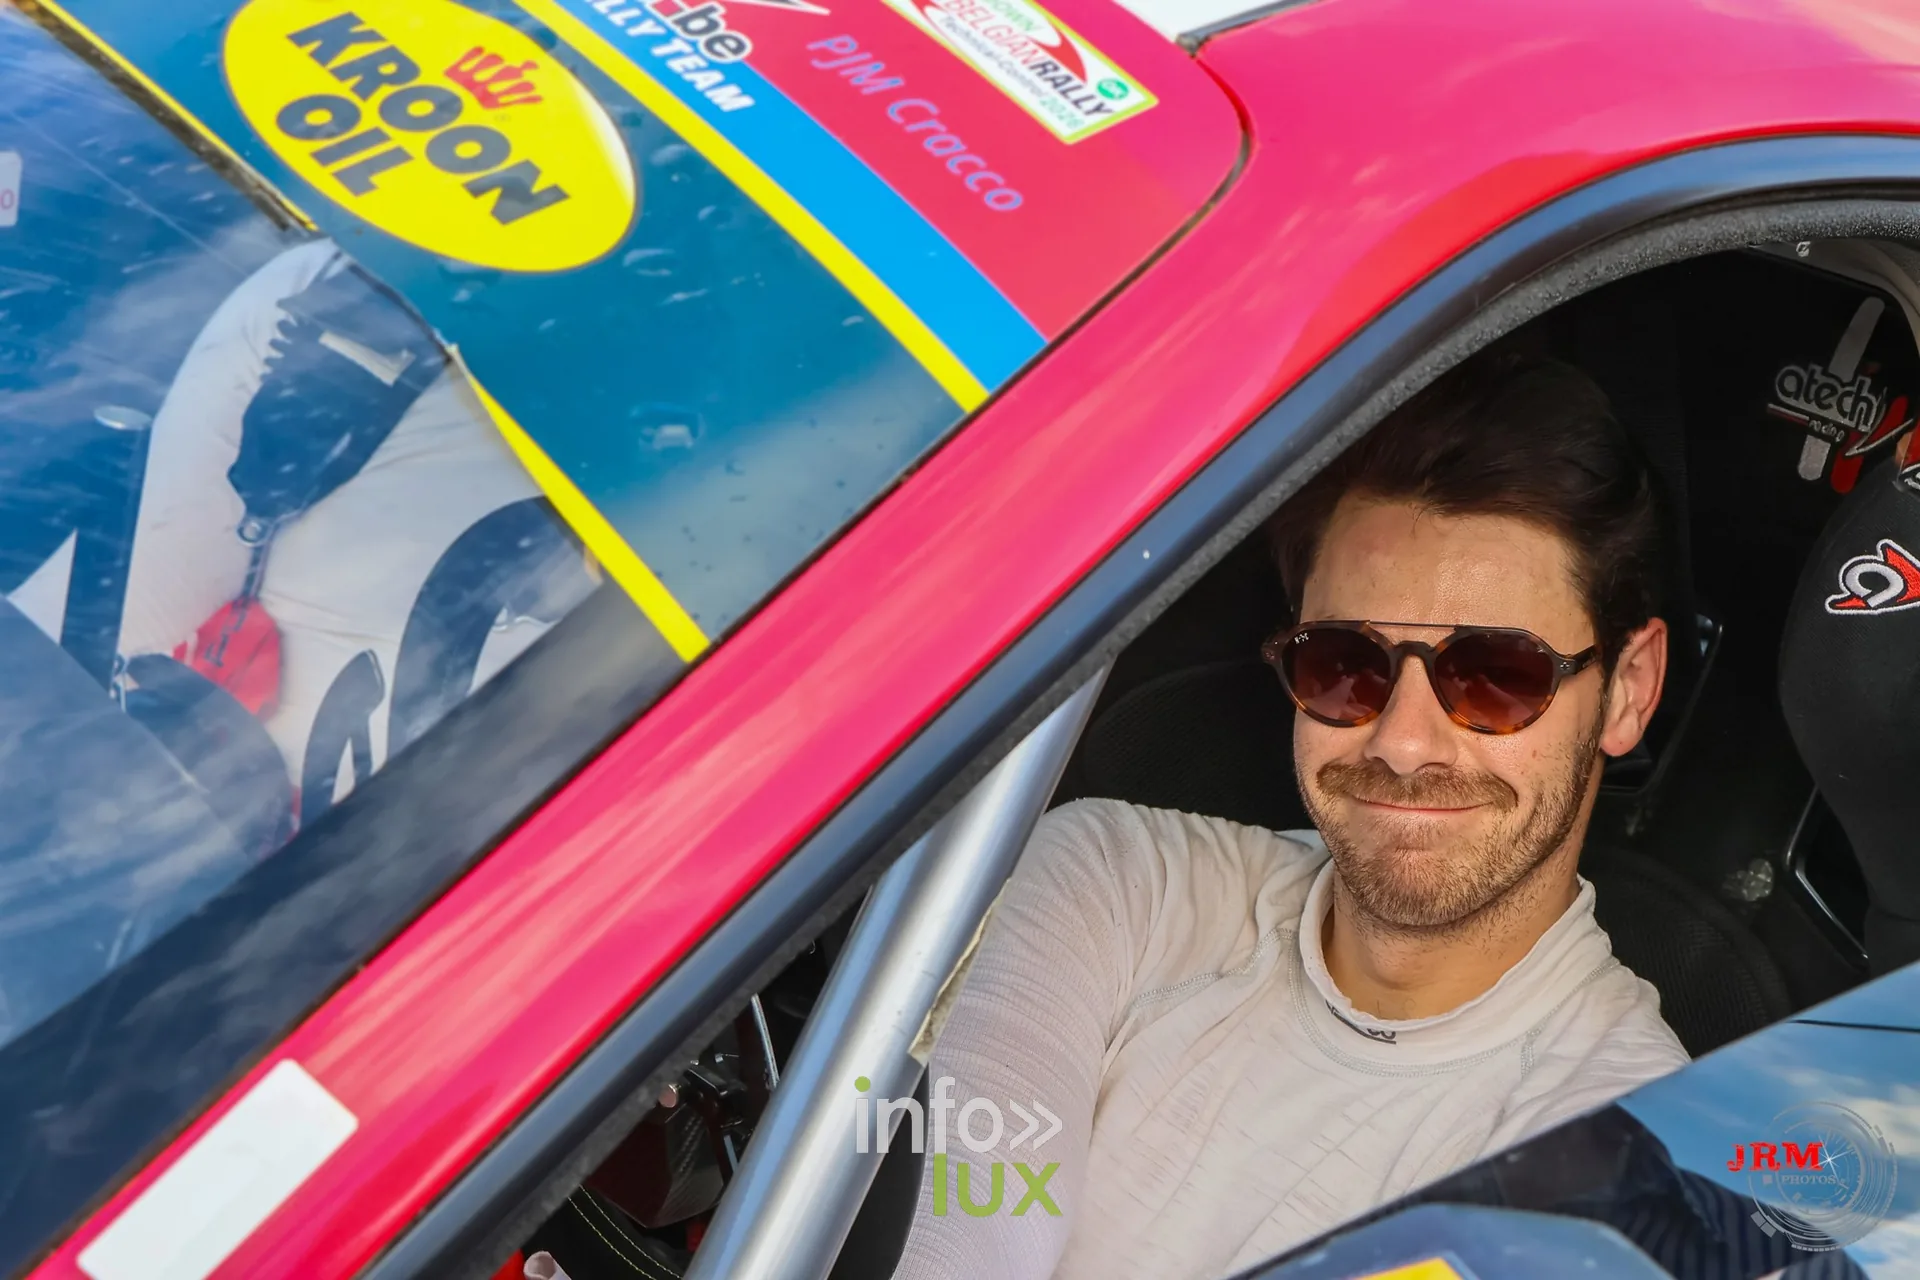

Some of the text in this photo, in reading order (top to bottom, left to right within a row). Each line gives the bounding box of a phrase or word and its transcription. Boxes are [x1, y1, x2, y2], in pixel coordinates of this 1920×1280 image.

[286, 11, 570, 225] KROON
[650, 36, 755, 112] TEAM
[806, 33, 1023, 211] PJM Cracco
[276, 93, 414, 197] OIL
